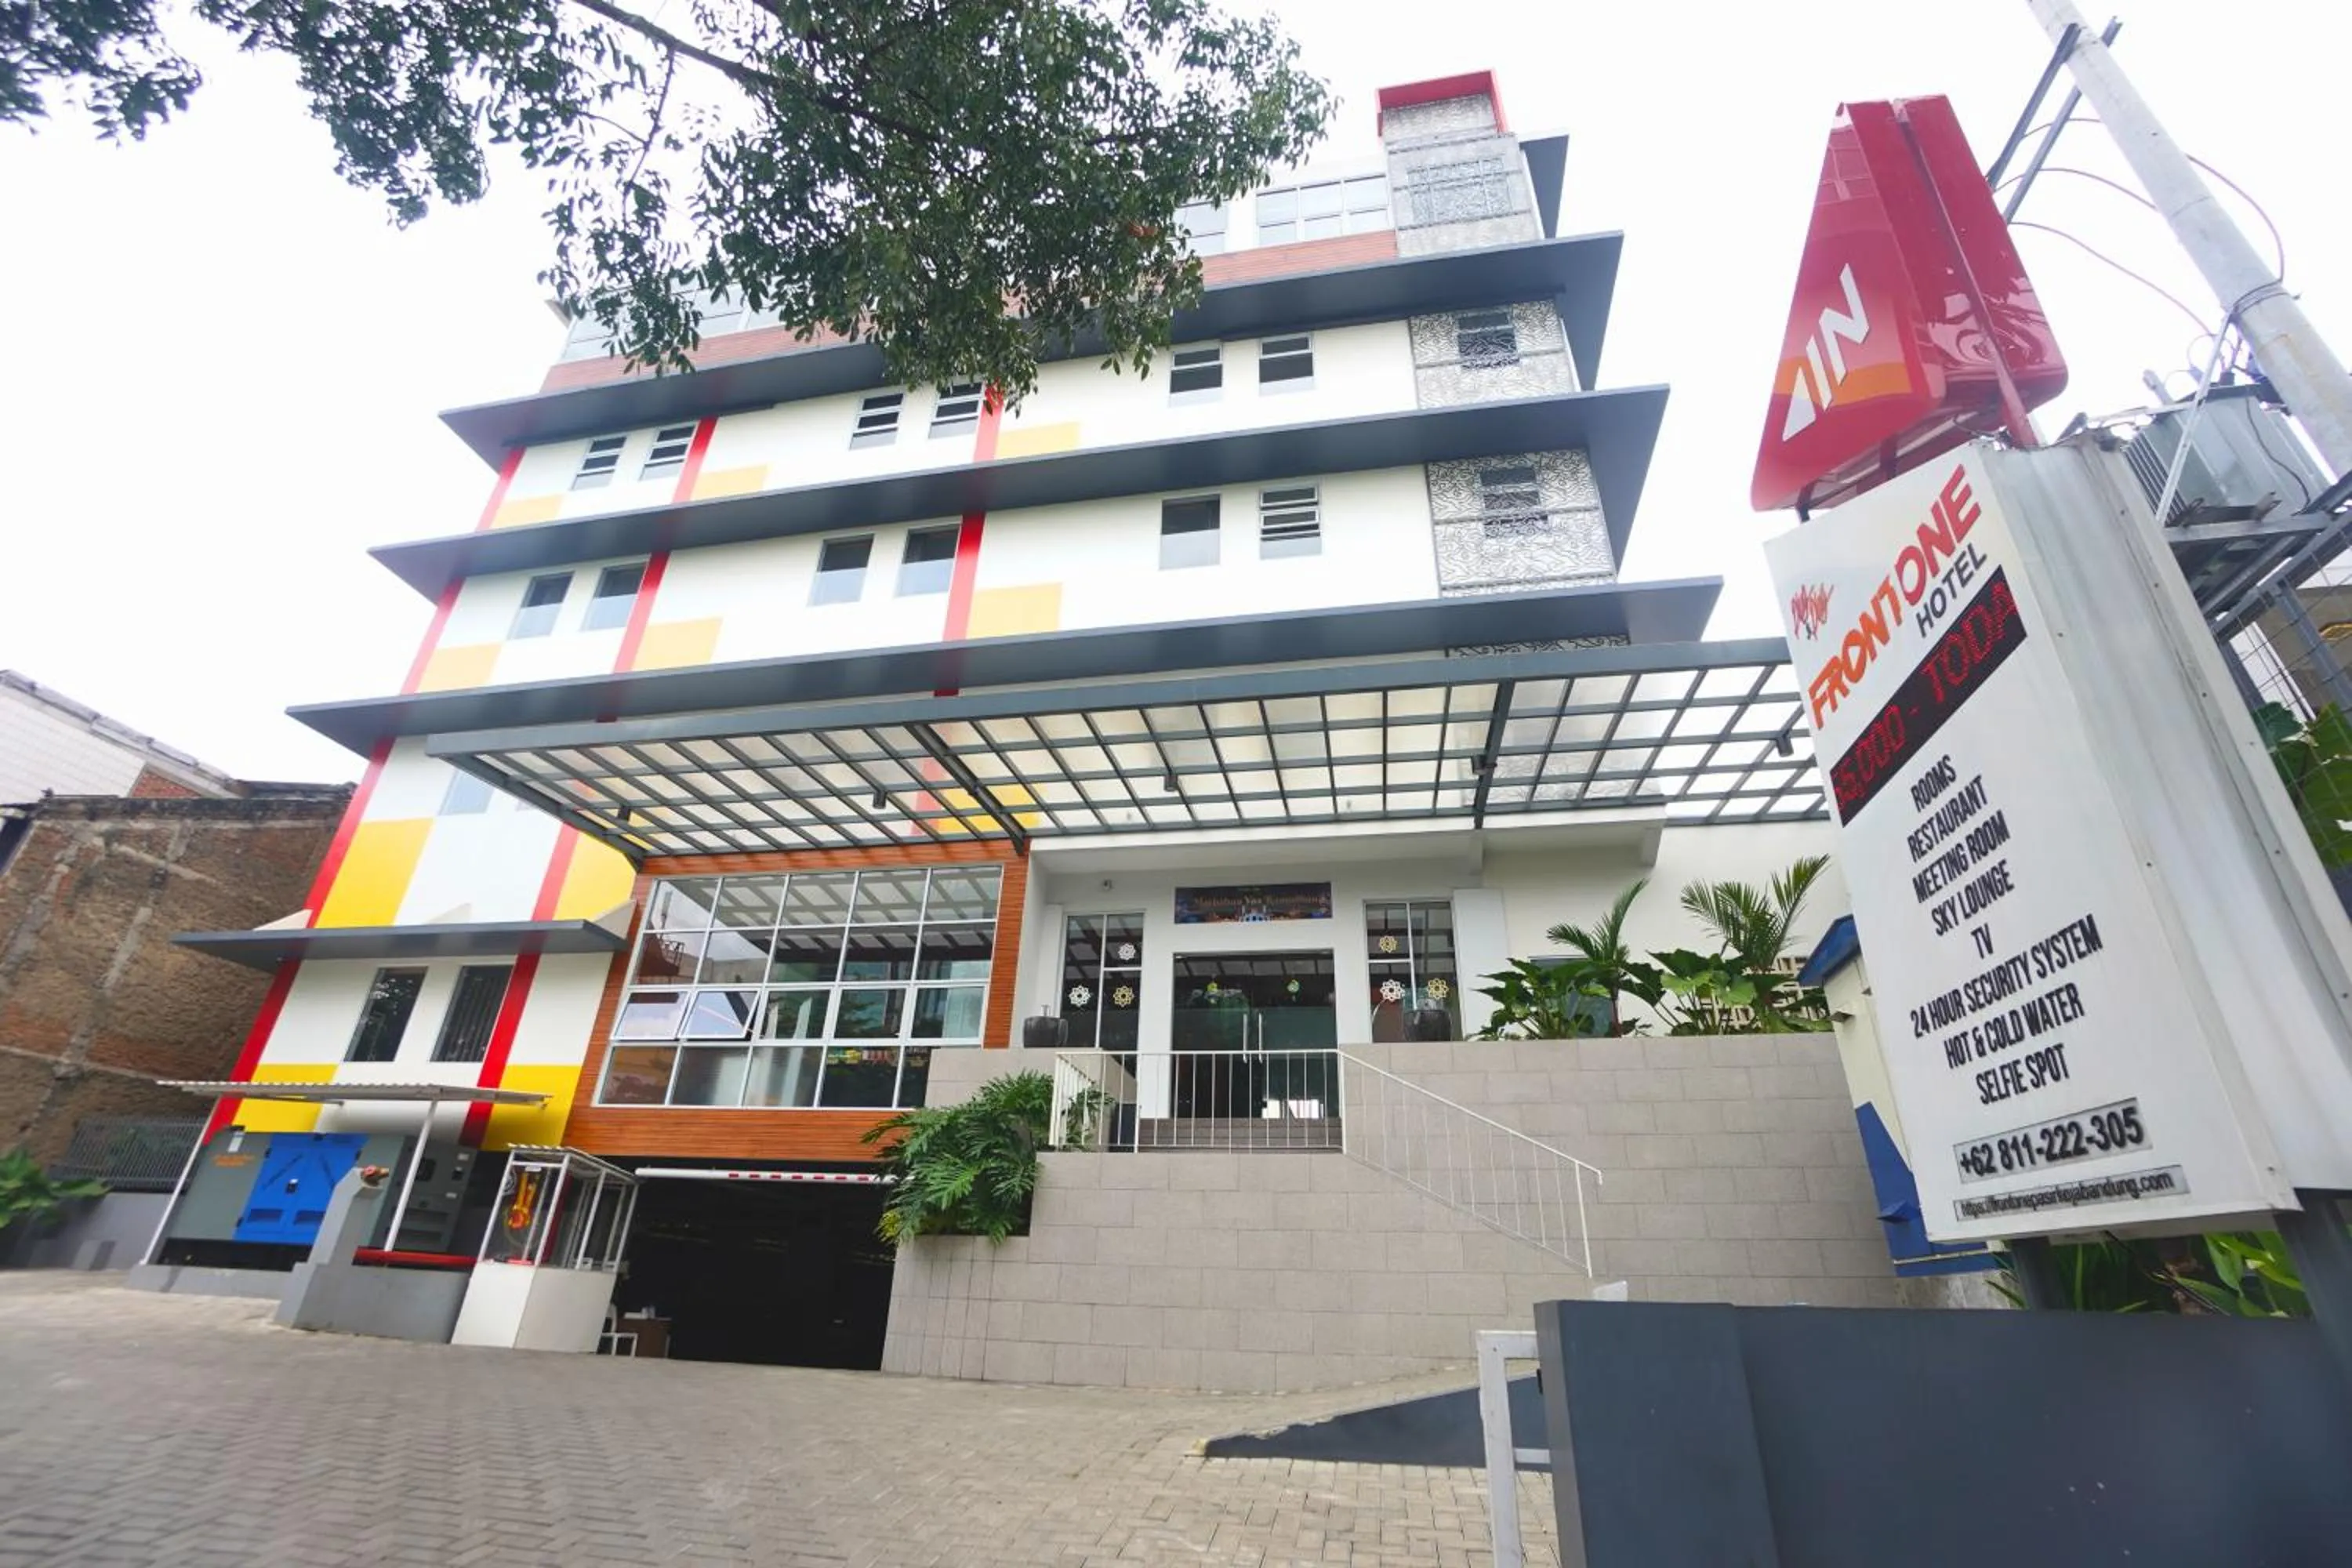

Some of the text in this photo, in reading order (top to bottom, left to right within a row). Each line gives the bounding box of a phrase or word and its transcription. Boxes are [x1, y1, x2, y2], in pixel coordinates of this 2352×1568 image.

[1915, 543, 1987, 638] HOTEL
[1907, 774, 1988, 863] RESTAURANT
[1911, 754, 1957, 813] ROOMS
[1912, 810, 2011, 903] MEETING ROOM
[1931, 858, 2015, 936] SKY LOUNGE
[1910, 913, 2103, 1039] 24 HOUR SECURITY SYSTEM
[1970, 922, 1994, 960] TV
[1944, 982, 2085, 1069] HOT & COLD WATER
[1976, 1043, 2070, 1105] SELFIE SPOT
[1960, 1105, 2145, 1177] +62 811-222-305
